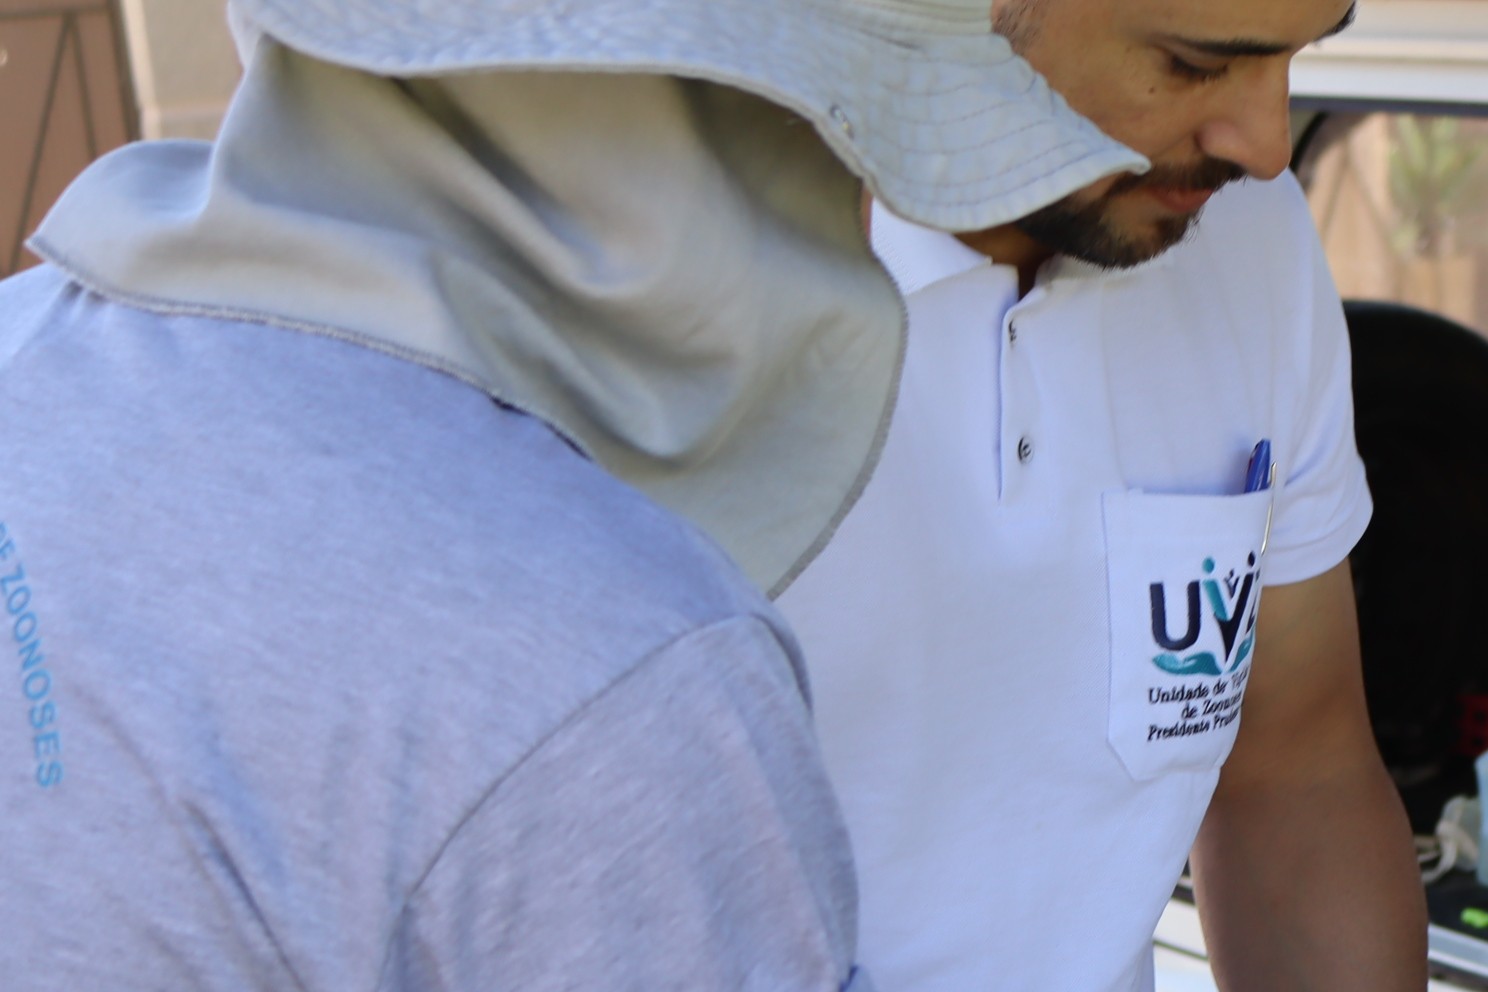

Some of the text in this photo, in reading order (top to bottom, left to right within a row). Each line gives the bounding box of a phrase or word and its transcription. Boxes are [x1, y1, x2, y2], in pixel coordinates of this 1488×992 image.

[0, 563, 65, 788] ZOONOSES
[1149, 682, 1209, 704] Unidade
[1181, 702, 1198, 719] de
[1147, 721, 1211, 742] Presidente
